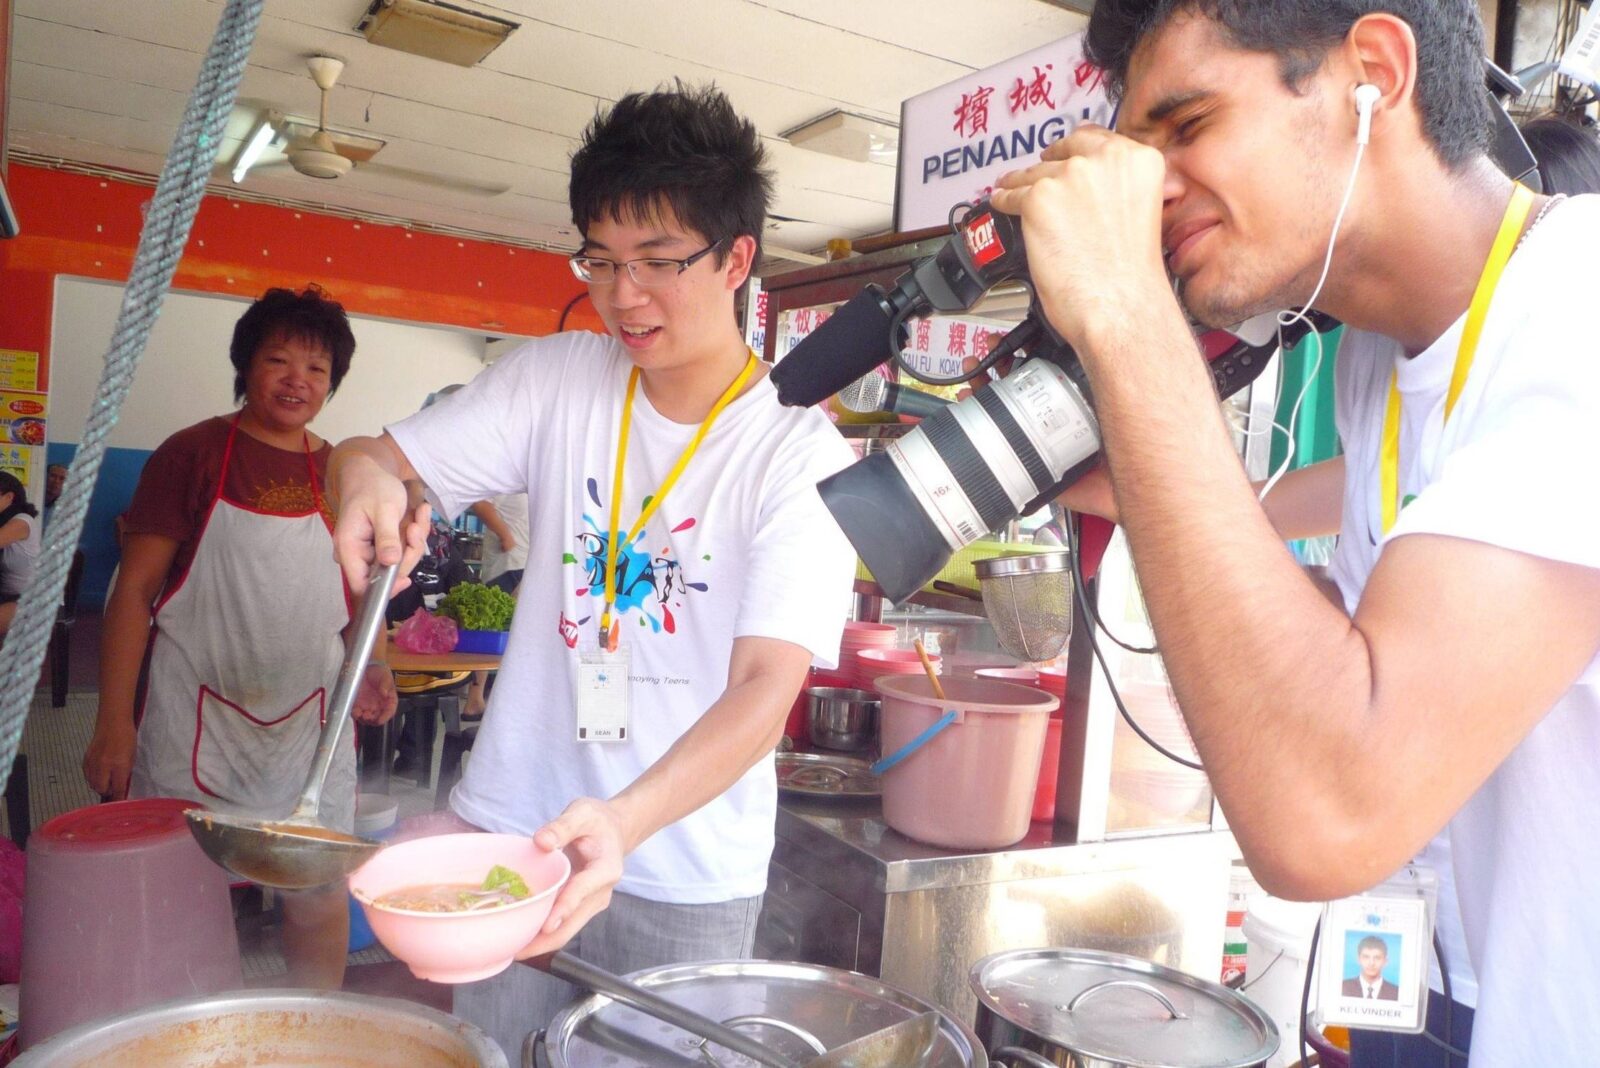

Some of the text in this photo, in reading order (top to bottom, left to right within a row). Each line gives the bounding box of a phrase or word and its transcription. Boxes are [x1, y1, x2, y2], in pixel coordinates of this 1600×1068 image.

[922, 117, 1066, 184] PENANG
[903, 353, 960, 376] TAU FU KOAY
[663, 675, 690, 685] Teens
